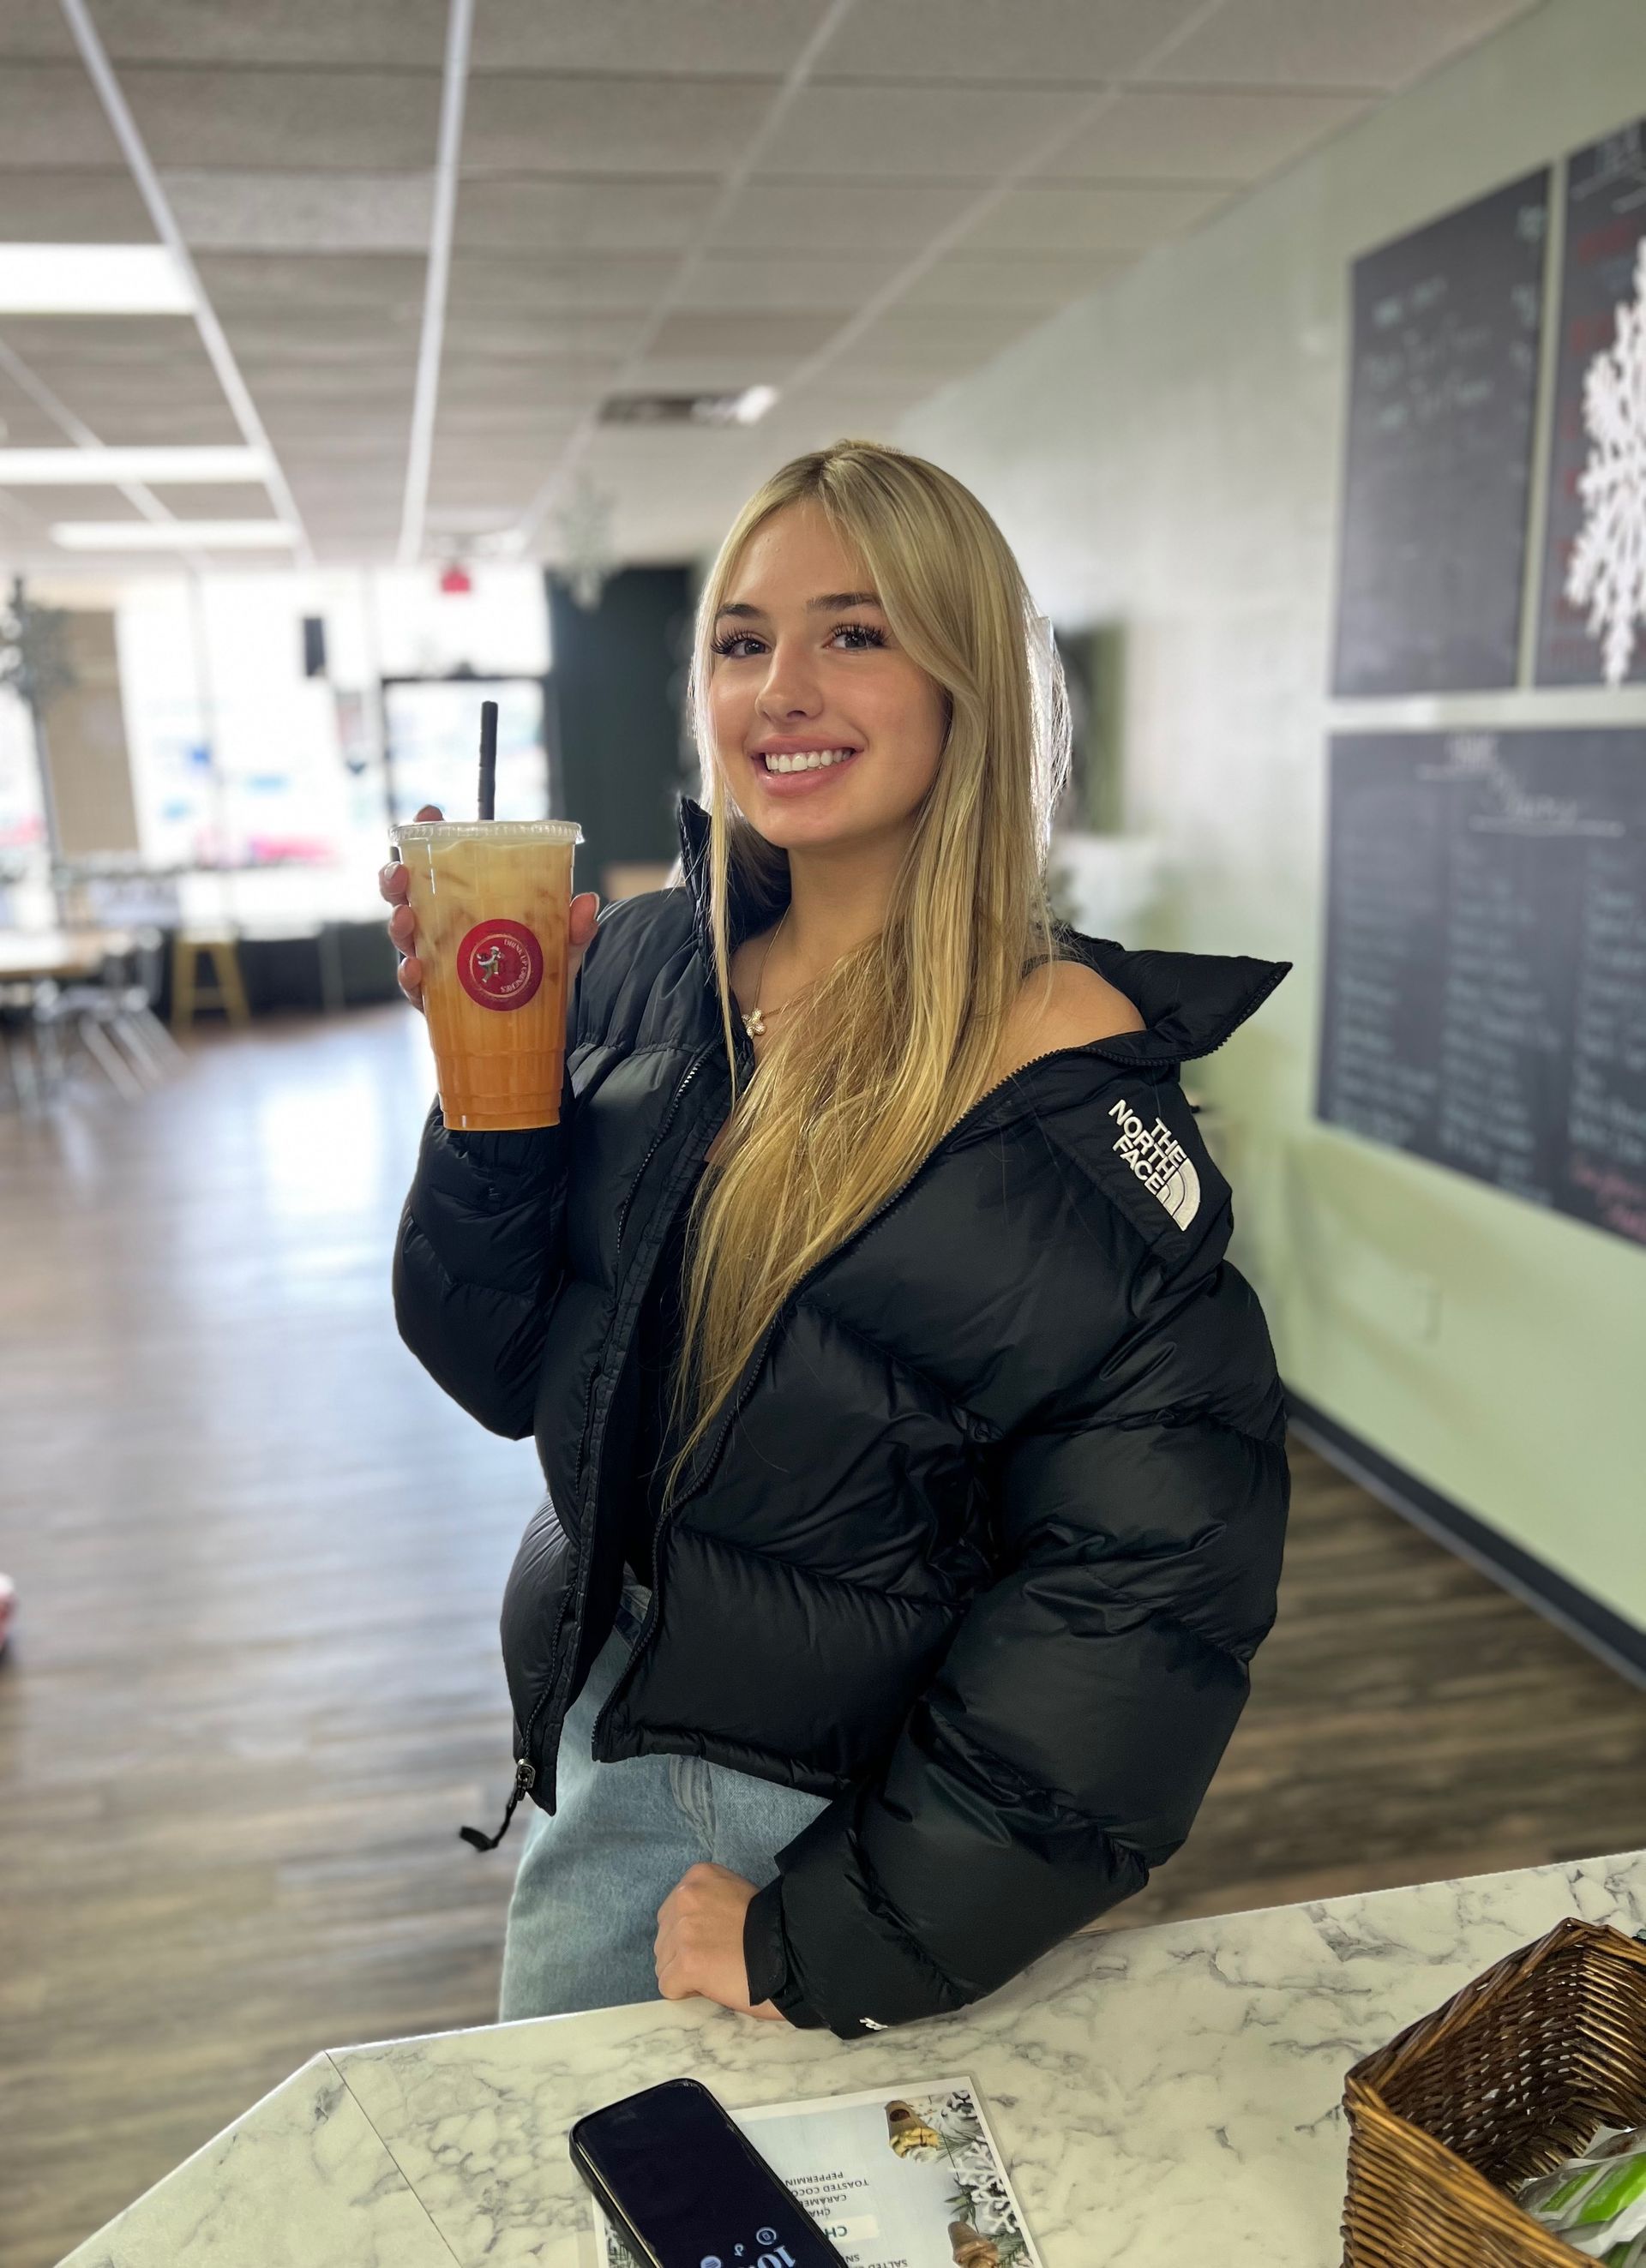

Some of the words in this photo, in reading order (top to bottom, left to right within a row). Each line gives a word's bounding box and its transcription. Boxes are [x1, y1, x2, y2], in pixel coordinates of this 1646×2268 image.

[1108, 1099, 1177, 1181] NORTH
[1112, 1134, 1165, 1196] FACE
[1150, 1117, 1187, 1168] THE
[823, 2179, 869, 2193] TOASTED
